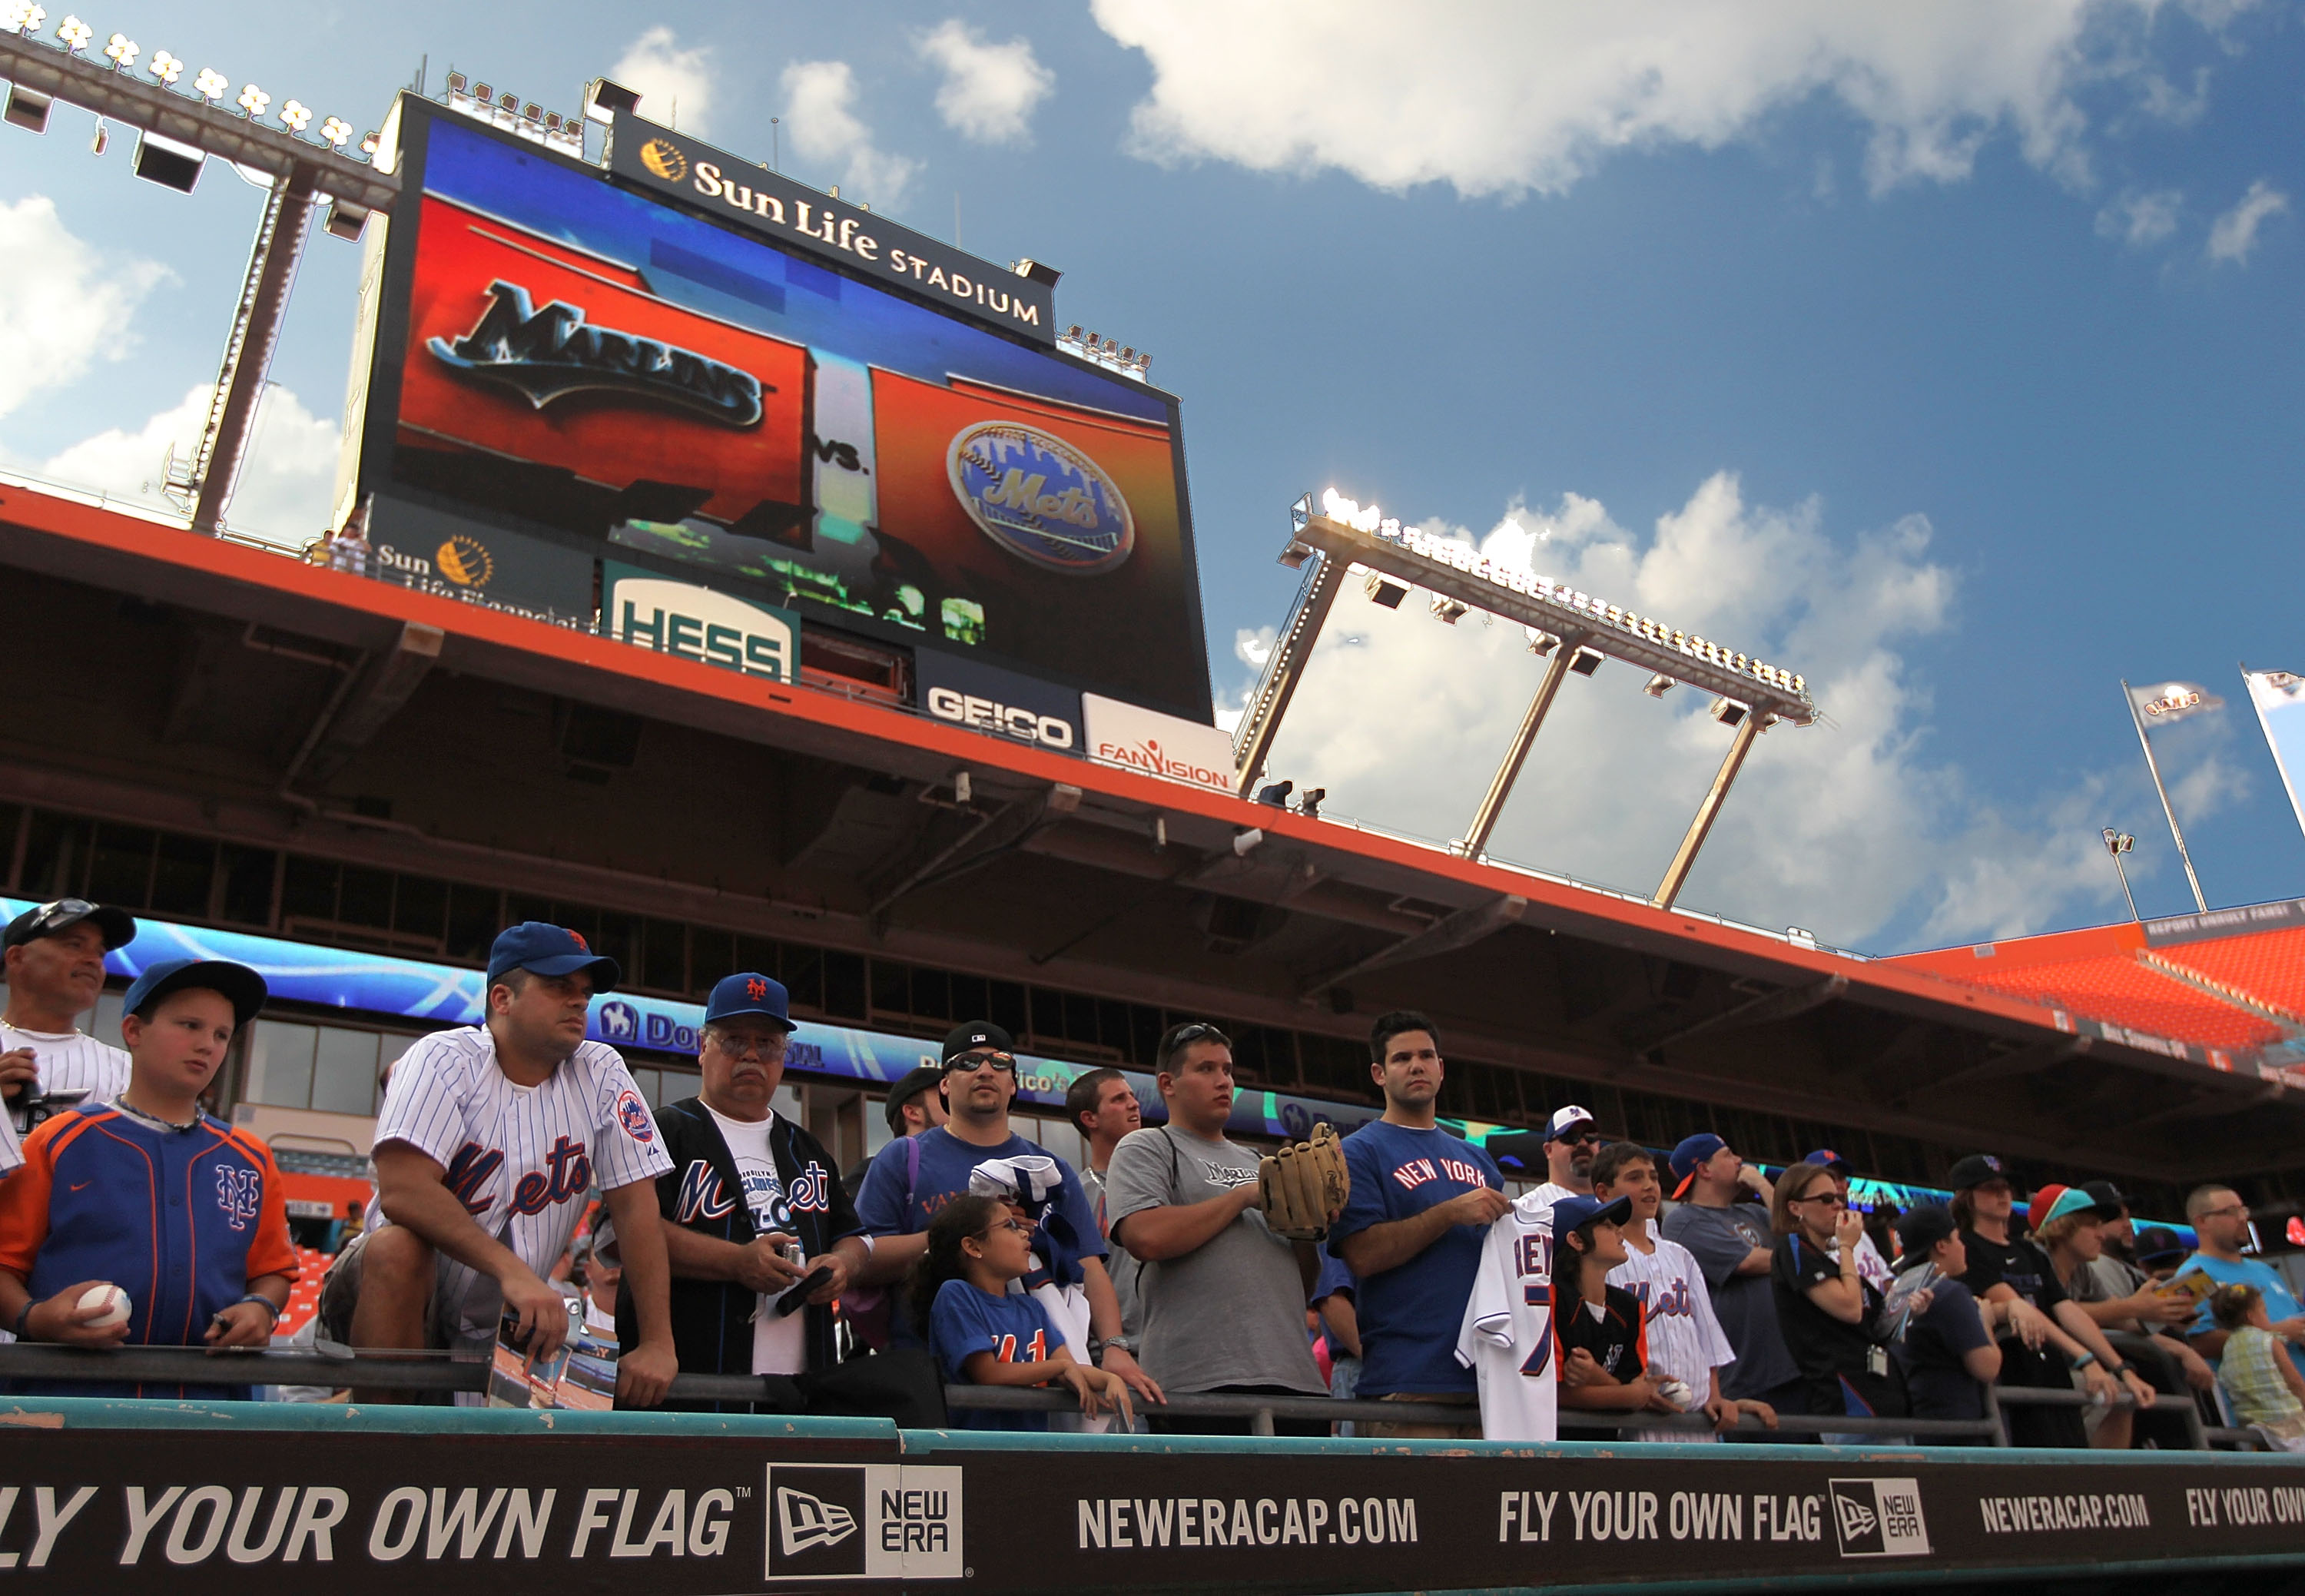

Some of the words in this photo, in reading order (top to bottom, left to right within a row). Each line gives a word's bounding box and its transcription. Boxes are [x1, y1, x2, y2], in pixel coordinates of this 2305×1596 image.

[694, 161, 787, 224] Sun
[794, 200, 878, 260] Life
[890, 248, 1040, 326] STADIUM
[982, 469, 1099, 529] Mets
[376, 544, 430, 575] Sun
[623, 599, 781, 682] HESS
[927, 686, 1073, 749] GEICO
[442, 1134, 591, 1216] Mets
[673, 1159, 830, 1224] Met
[1394, 1158, 1438, 1190] NEW
[1440, 1158, 1486, 1188] YORK
[119, 1485, 350, 1564] YOUR
[369, 1486, 556, 1561] OWN
[571, 1488, 735, 1558] FLAG
[881, 1489, 948, 1520] NEW
[1078, 1498, 1418, 1548] NEWERACAP.COM
[1499, 1491, 1559, 1542] FLY
[1568, 1491, 1659, 1541] YOUR
[1669, 1491, 1743, 1541] OWN
[1753, 1494, 1821, 1541] FLAG
[1882, 1494, 1915, 1516] NEW
[1886, 1515, 1920, 1538] ERA
[1979, 1493, 2151, 1534] NEWERACAP.COM
[2185, 1488, 2219, 1526] FLY
[2220, 1487, 2272, 1526] YOUR
[881, 1522, 948, 1552] ERA
